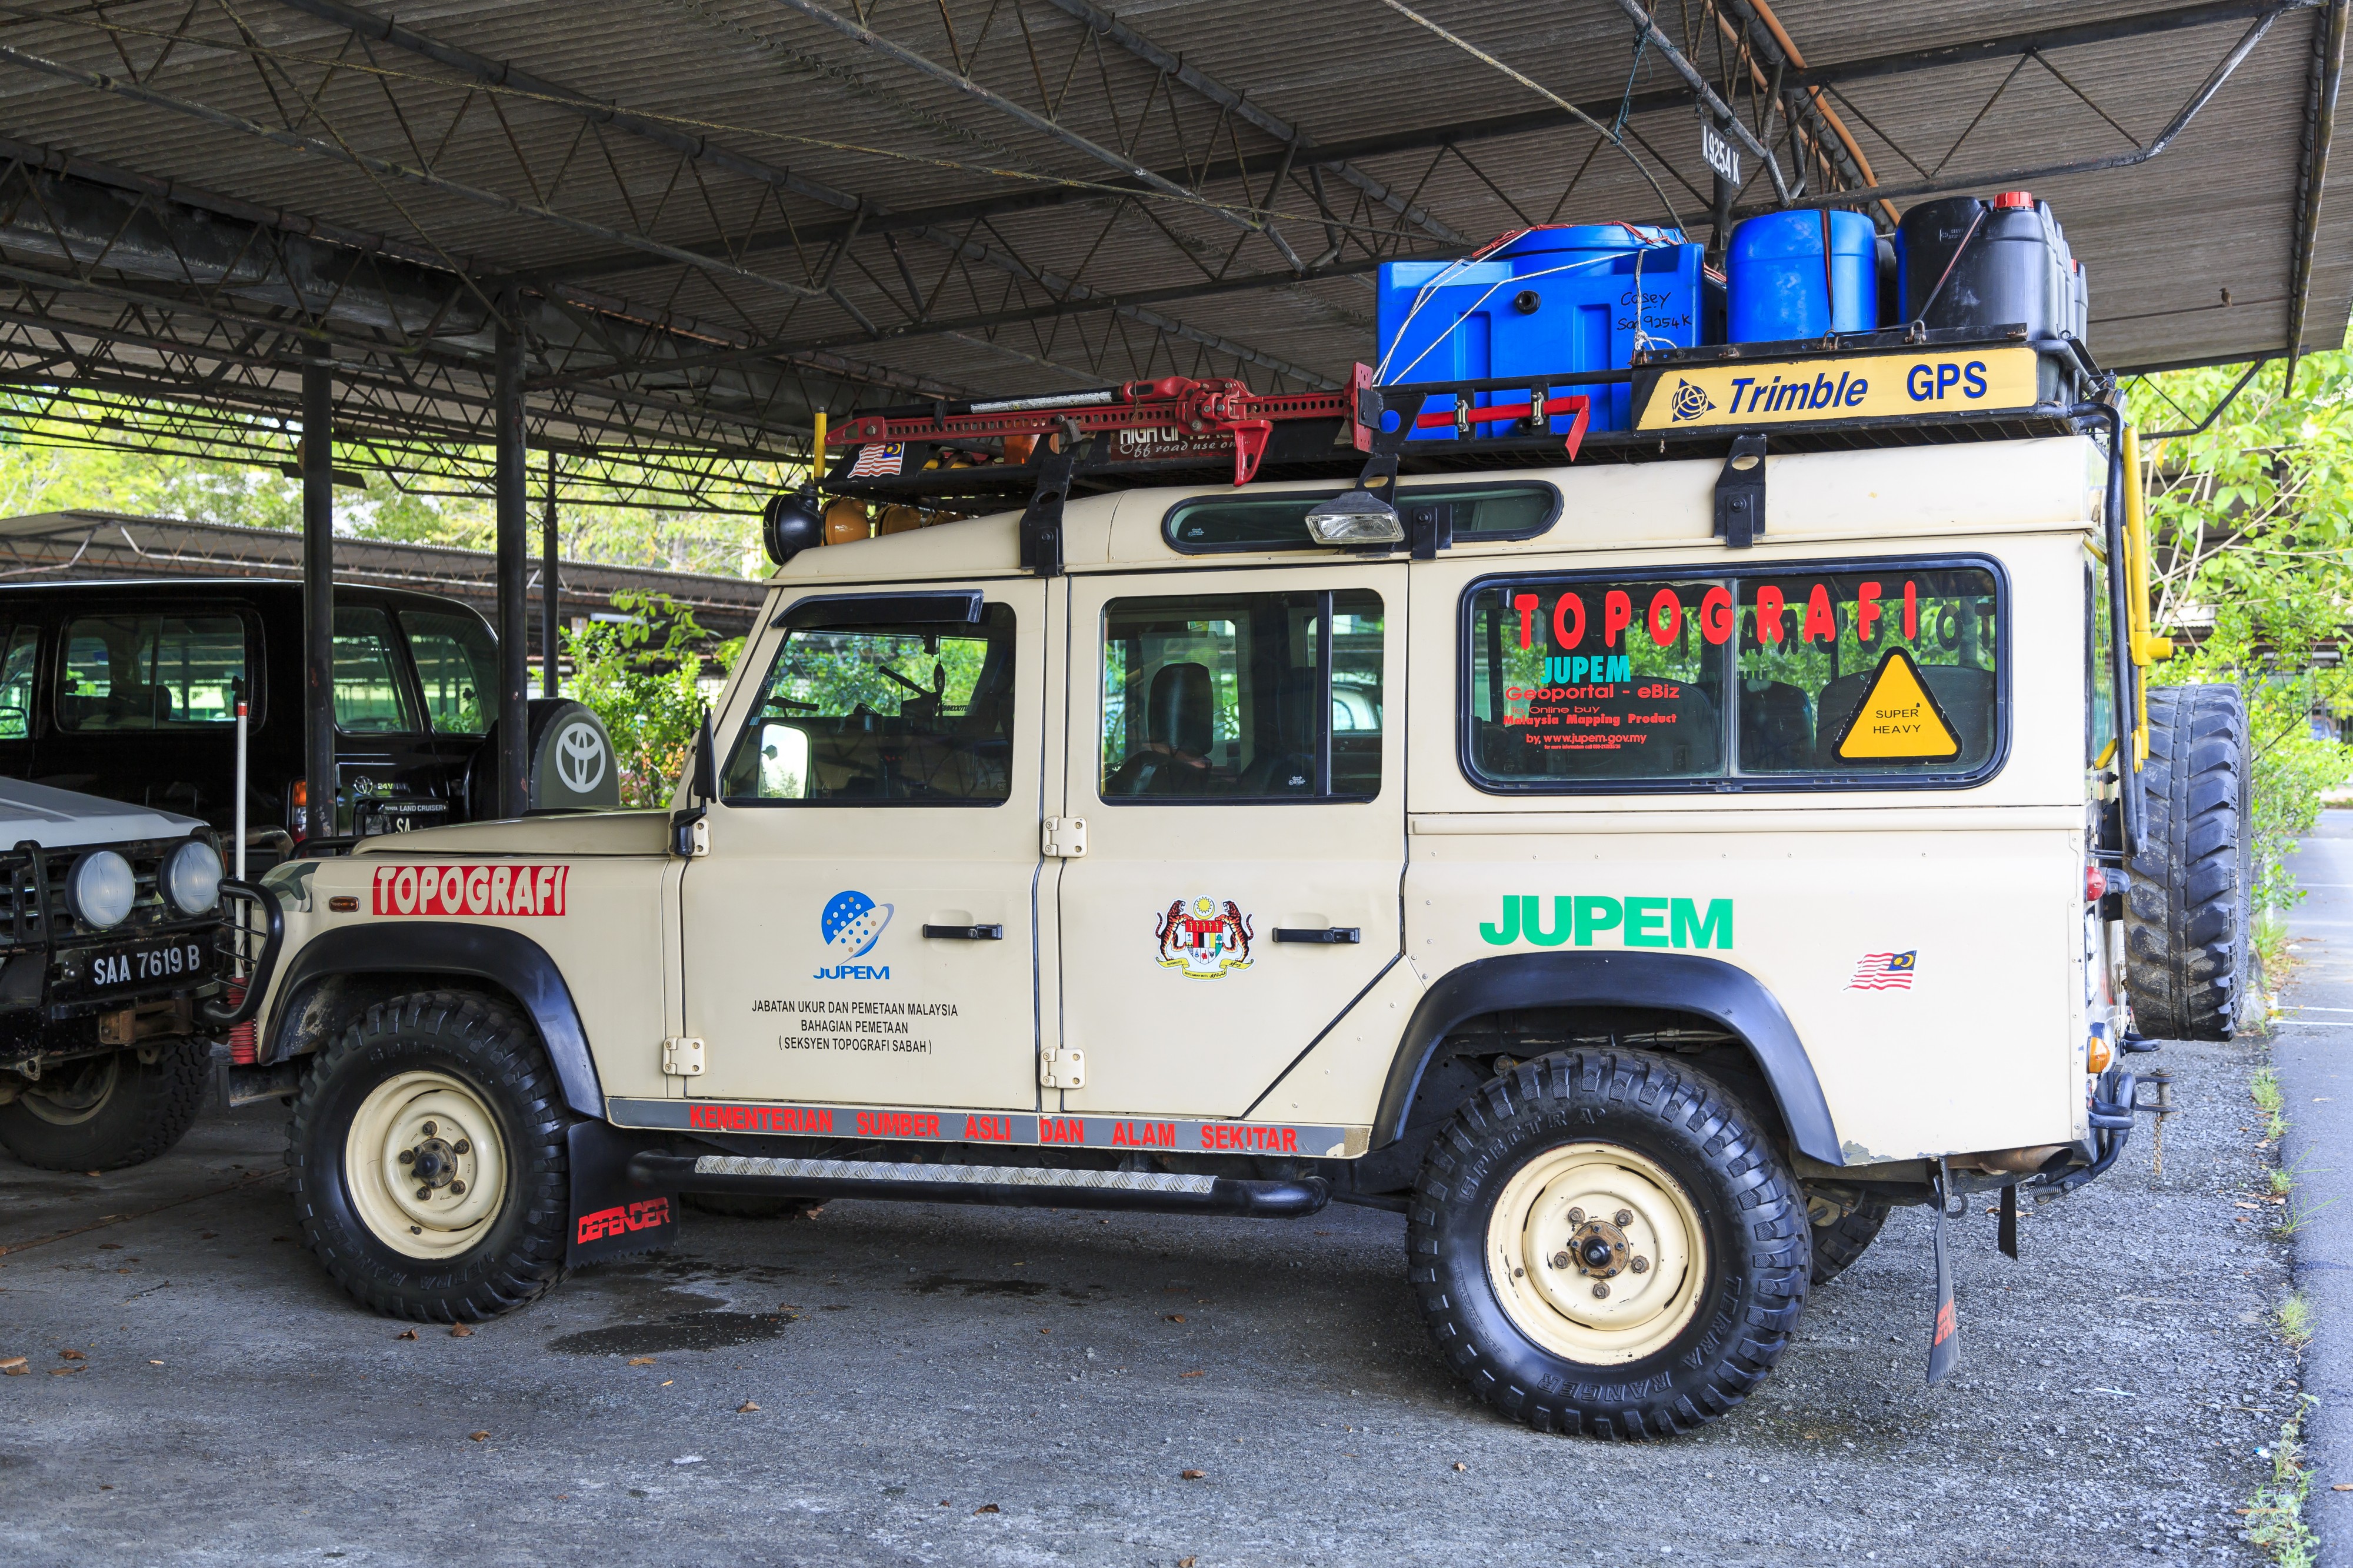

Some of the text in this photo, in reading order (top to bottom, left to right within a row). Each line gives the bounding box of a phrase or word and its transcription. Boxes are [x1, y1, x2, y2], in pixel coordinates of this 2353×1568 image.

[1709, 132, 1731, 179] 9254
[1733, 151, 1740, 185] K
[1728, 361, 1988, 414] Trimble GPS
[1119, 443, 1151, 458] Off
[1155, 441, 1188, 453] road
[1192, 442, 1216, 451] use
[1514, 581, 1916, 650] TOPOGRAFI
[1540, 655, 1631, 684] JUPEM
[1505, 683, 1614, 702] Geoportal
[1637, 683, 1680, 699] eBiz
[1574, 706, 1600, 714] buy
[1875, 709, 1919, 719] SUPER
[1503, 712, 1677, 728] Malaysia Mapping Product
[1873, 724, 1921, 734] HEAVY
[1543, 733, 1647, 745] www.jupem.gov.my
[377, 866, 565, 915] TOPOGRAFI
[1479, 895, 1734, 949] JUPEM
[94, 945, 200, 985] SAA 7619 B
[812, 965, 890, 980] JUPEM
[752, 1000, 958, 1016] JABATAN UKUR DAN PEMETAAN MALAYSIA
[801, 1019, 908, 1034] BAHAGIAN PEMETAAN
[832, 1037, 889, 1052] TOPOGRAFI
[689, 1105, 1298, 1152] KEMENTERIAN SUMBER ASLI DAN ALAM SEKITAR
[578, 1197, 671, 1245] DEFENDER
